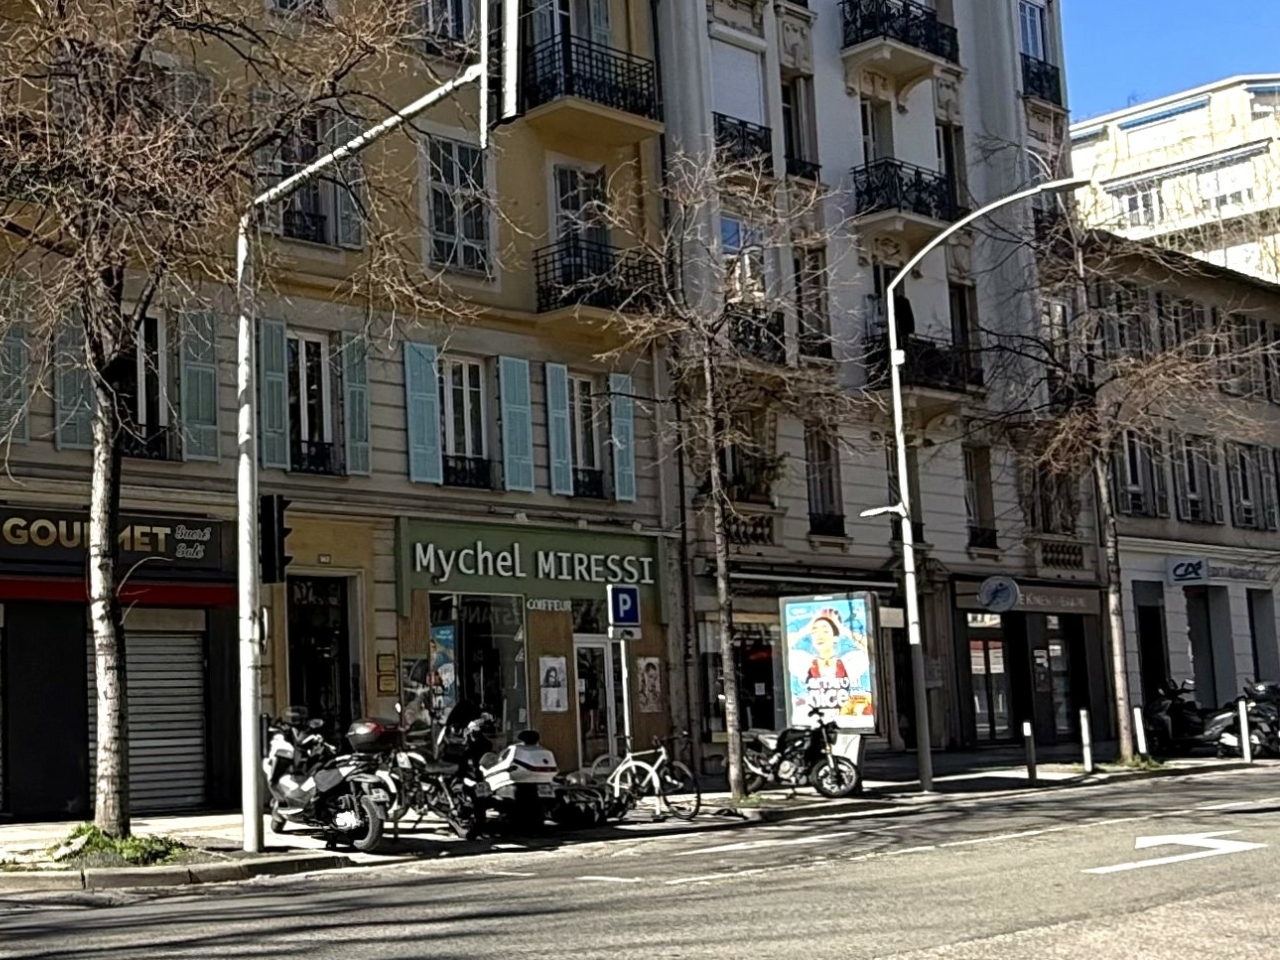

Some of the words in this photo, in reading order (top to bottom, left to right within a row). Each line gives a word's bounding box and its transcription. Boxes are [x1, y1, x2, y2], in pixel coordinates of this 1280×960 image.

[536, 550, 655, 584] MIRESSI
[526, 598, 572, 612] COIFFEUR
[618, 593, 632, 618] P
